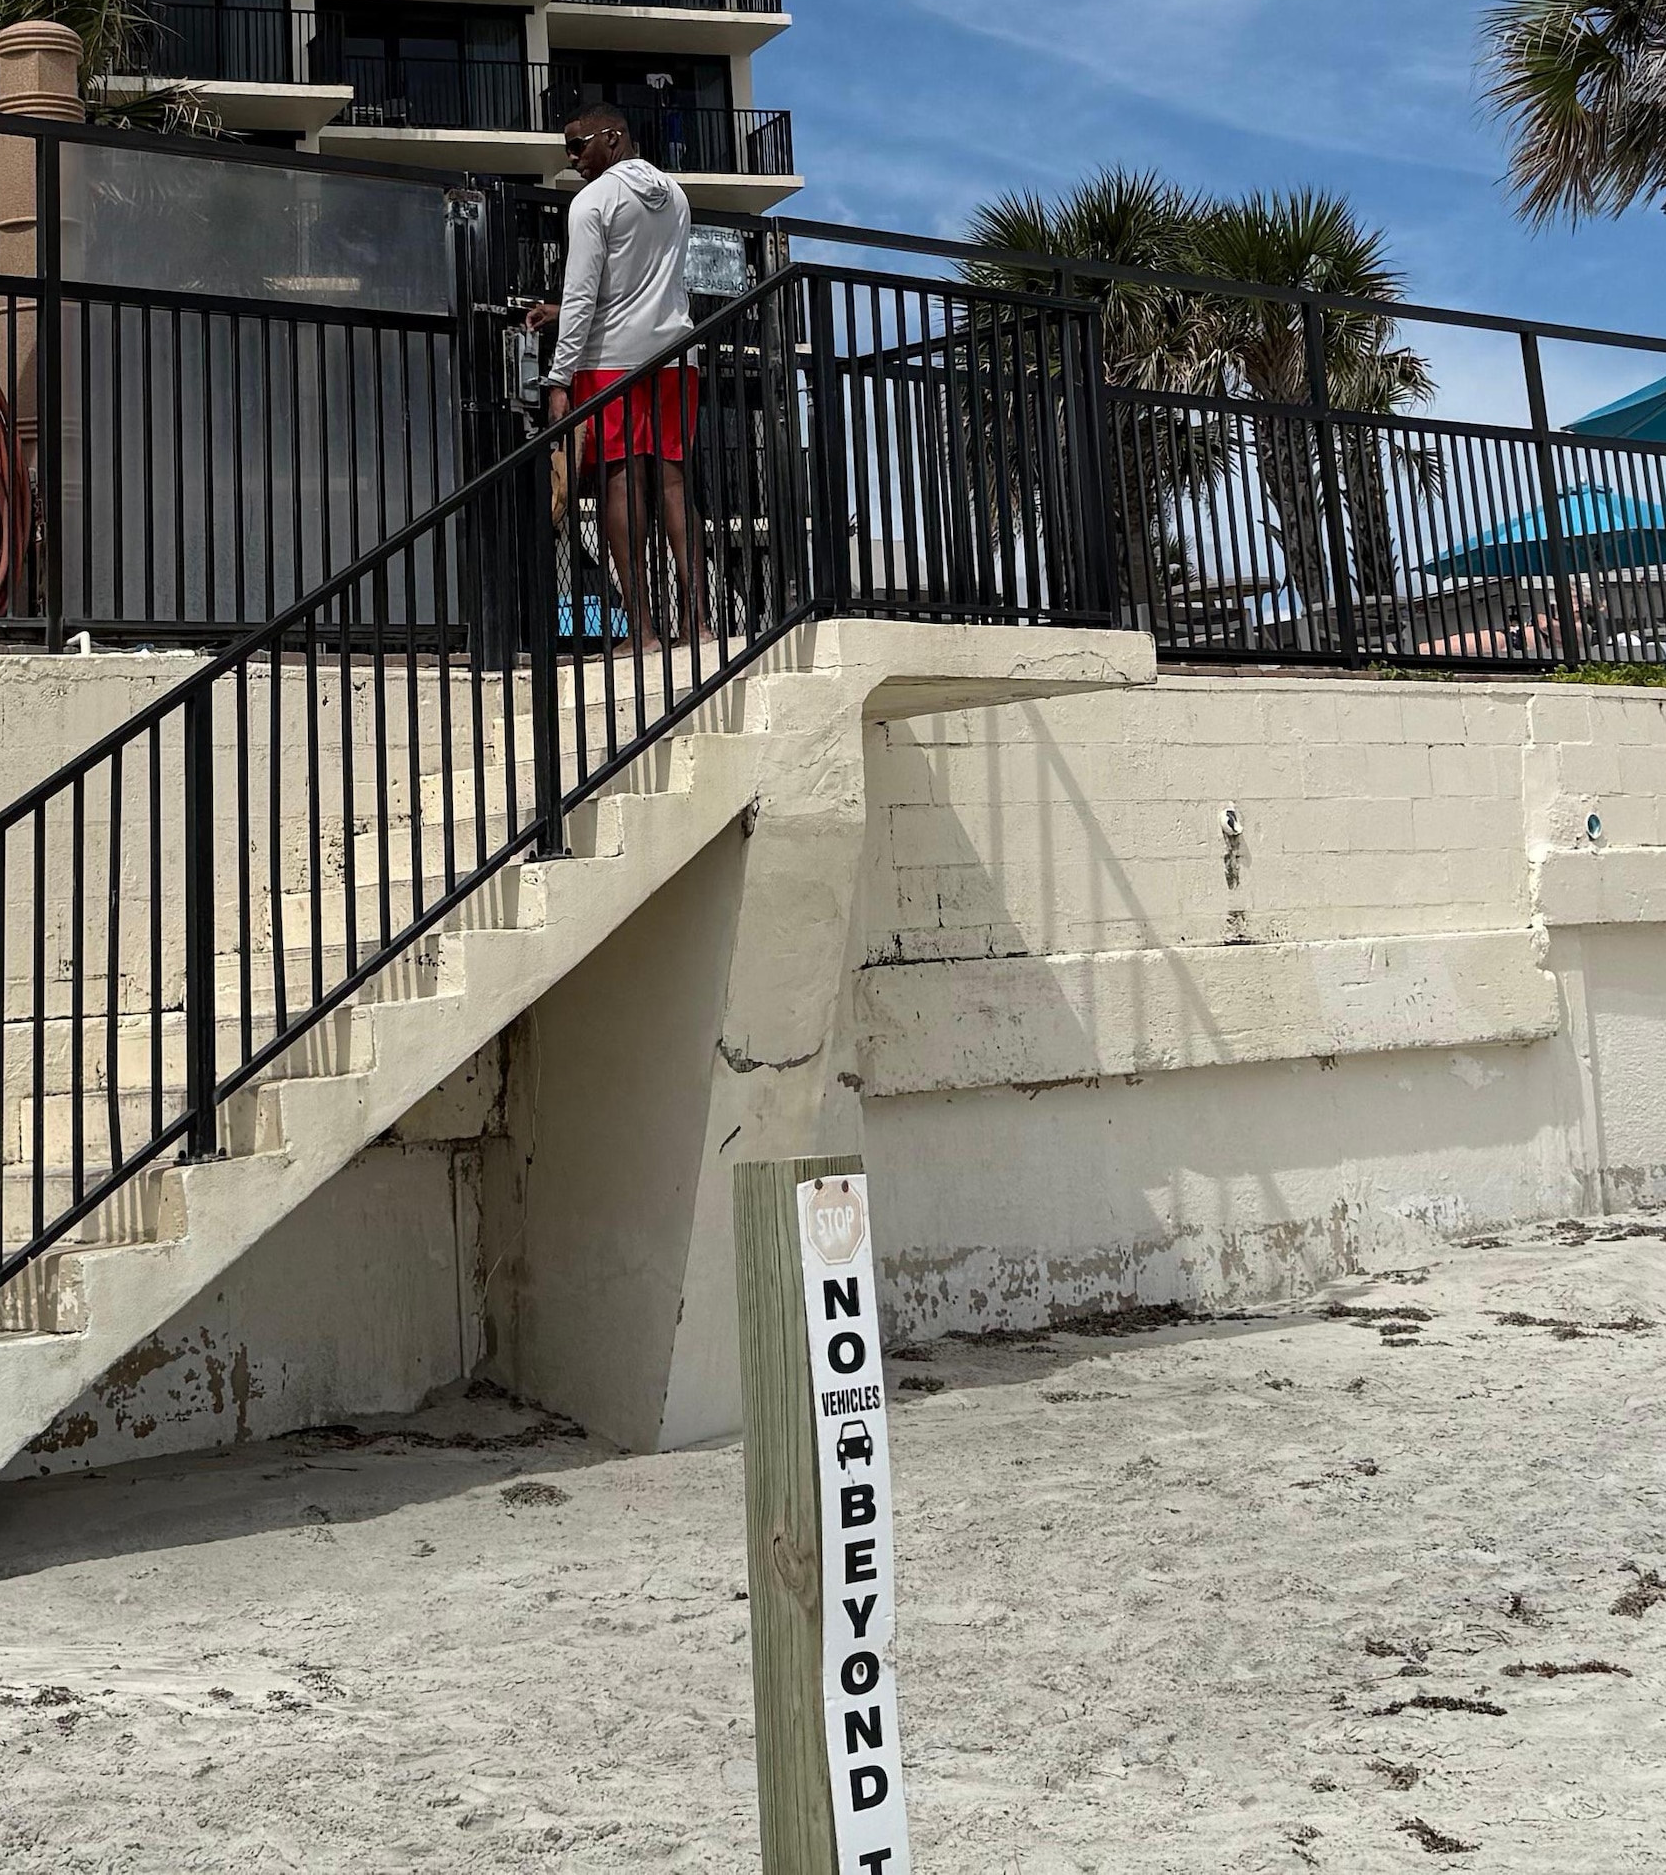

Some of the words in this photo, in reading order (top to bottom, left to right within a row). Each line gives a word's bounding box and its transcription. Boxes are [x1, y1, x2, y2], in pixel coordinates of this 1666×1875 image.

[816, 1205, 855, 1237] STOP
[823, 1277, 866, 1375] NO
[821, 1385, 881, 1417] VEHICLES
[840, 1483, 889, 1813] BEYOND
